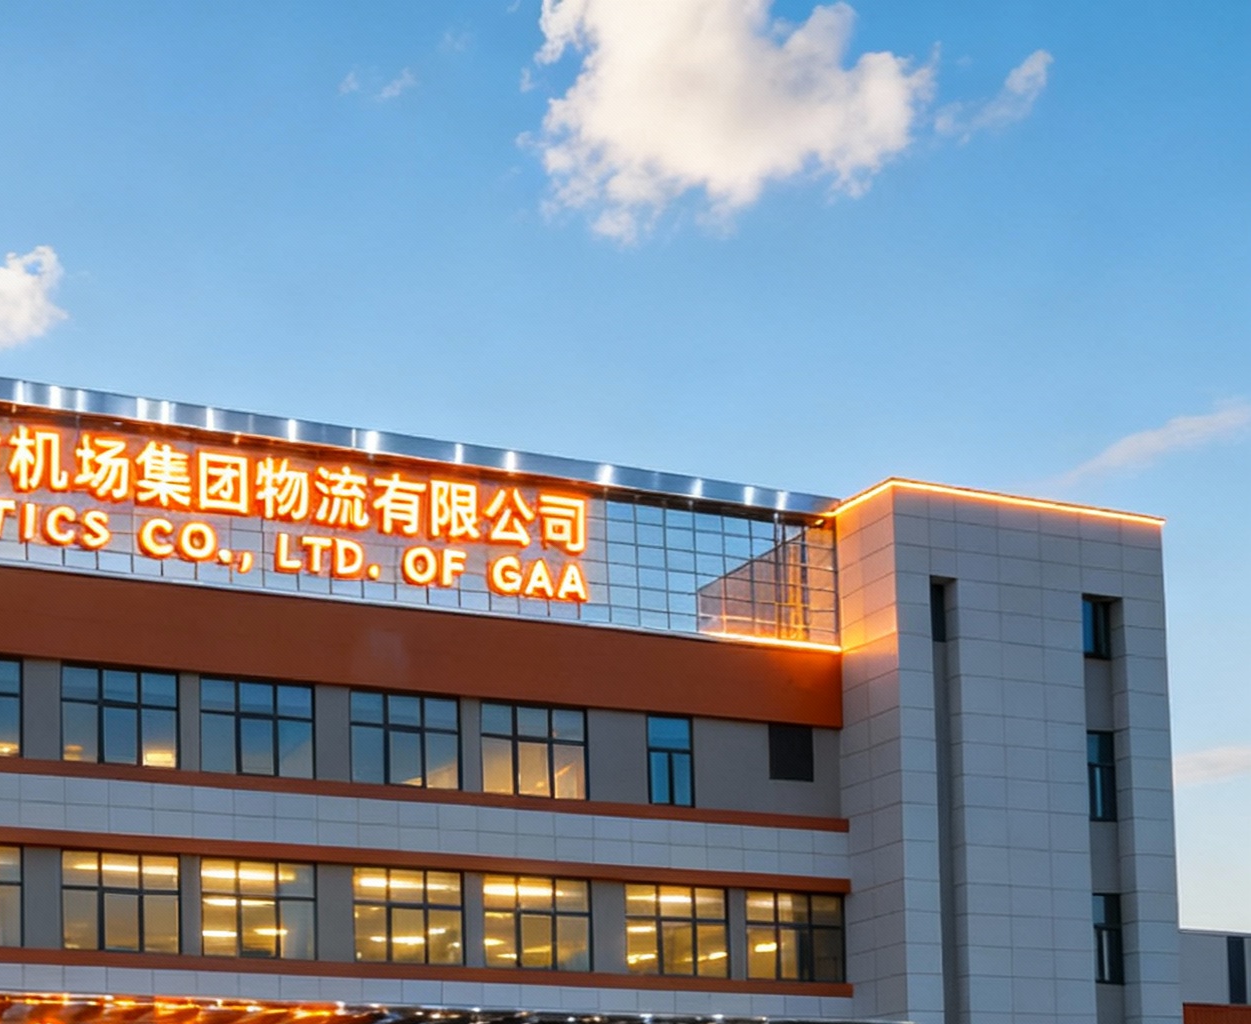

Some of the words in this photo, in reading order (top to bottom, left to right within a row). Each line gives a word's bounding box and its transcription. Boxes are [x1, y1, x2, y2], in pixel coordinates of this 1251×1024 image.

[139, 517, 254, 573] CO.,
[276, 533, 381, 581] LTD.
[403, 546, 467, 587] OF
[491, 555, 589, 602] GAA
